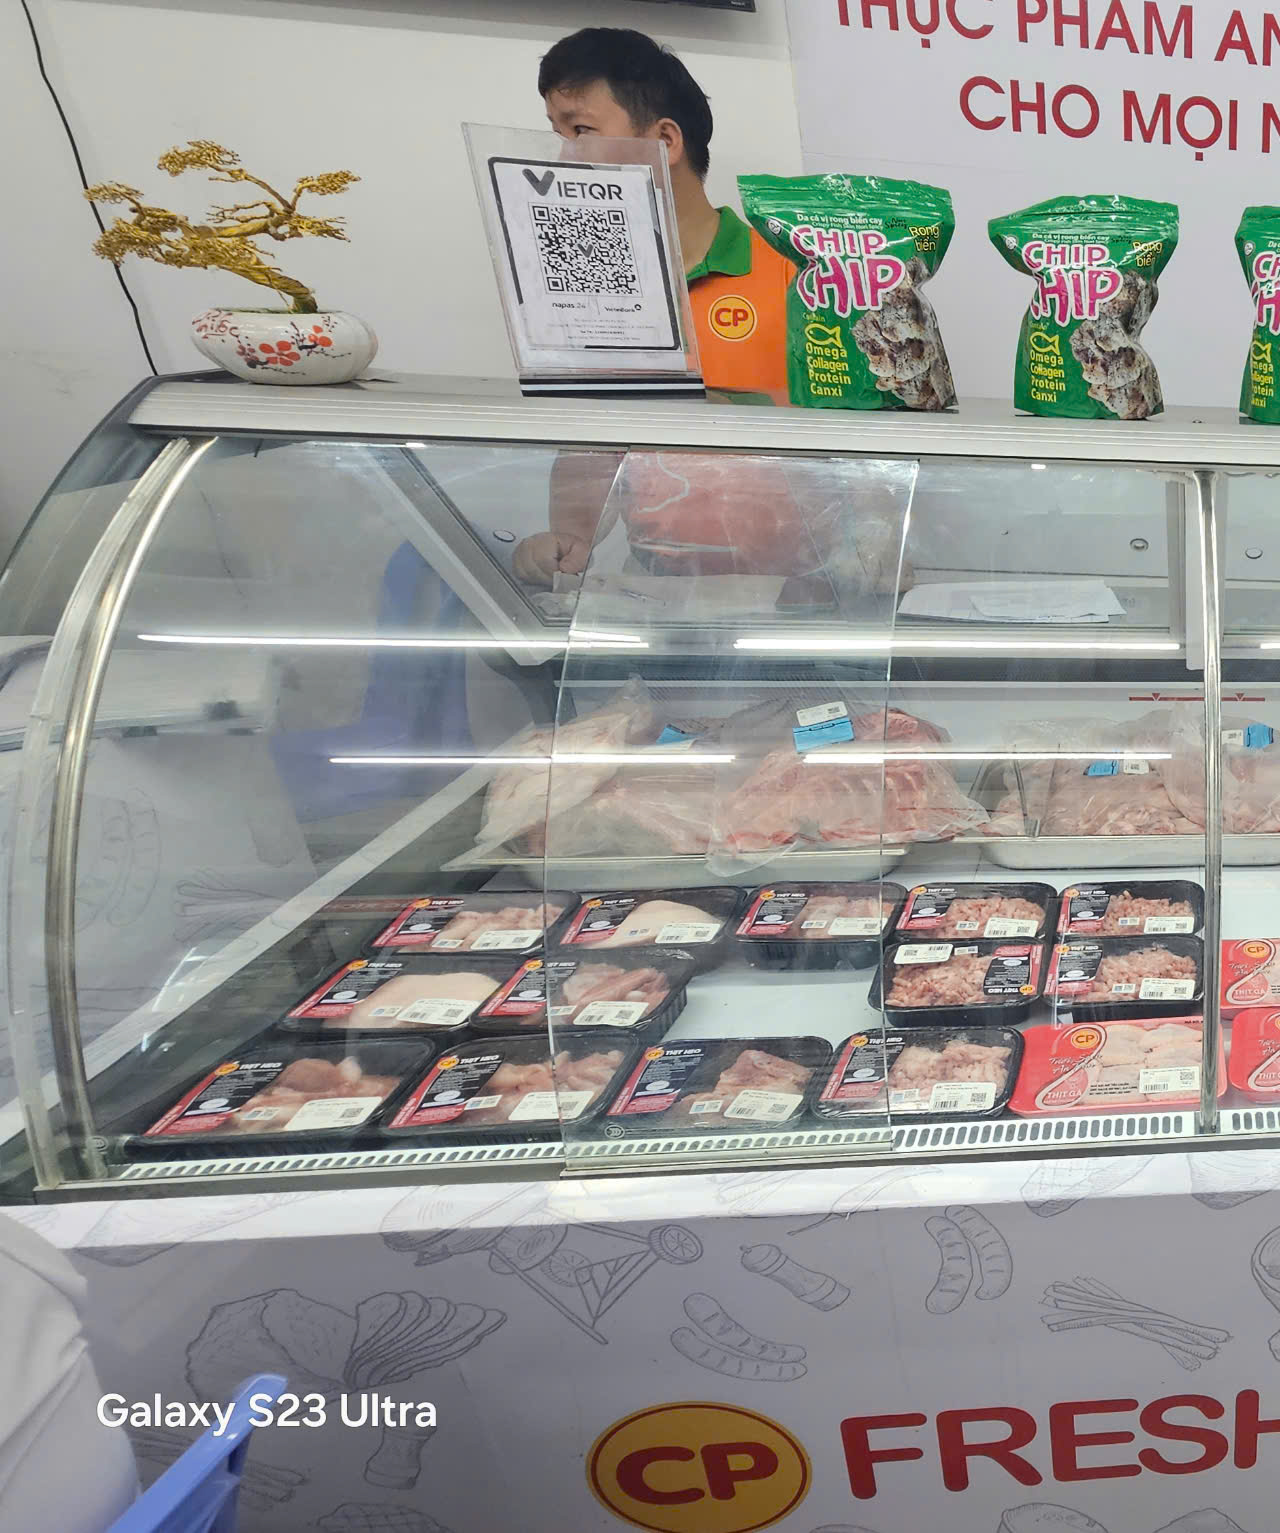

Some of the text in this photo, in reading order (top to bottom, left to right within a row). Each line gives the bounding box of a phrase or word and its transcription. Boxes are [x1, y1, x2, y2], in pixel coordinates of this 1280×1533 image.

[960, 75, 1100, 139] CHO
[1122, 89, 1238, 162] MỌI
[522, 168, 624, 201] VIETQR
[797, 213, 809, 221] Da
[810, 213, 820, 222] cá
[829, 216, 849, 225] rong
[868, 217, 883, 226] cay
[909, 226, 939, 239] Rong
[790, 225, 888, 257] CHIP
[915, 236, 936, 252] biển
[1268, 240, 1277, 248] Da
[1022, 241, 1110, 272] CHIP
[1030, 268, 1123, 327] HIP
[715, 307, 749, 327] CP
[805, 342, 848, 360] Omega
[1030, 351, 1064, 366] Omega
[807, 356, 849, 373] Collagen
[1030, 362, 1065, 379] Collagen
[808, 369, 852, 385] Protein
[1031, 376, 1066, 391] Protein
[810, 382, 843, 397] Canxi
[1031, 387, 1057, 403] Canxi
[1247, 946, 1265, 954] CP
[1075, 1034, 1095, 1044] CP
[616, 1441, 779, 1505] CP
